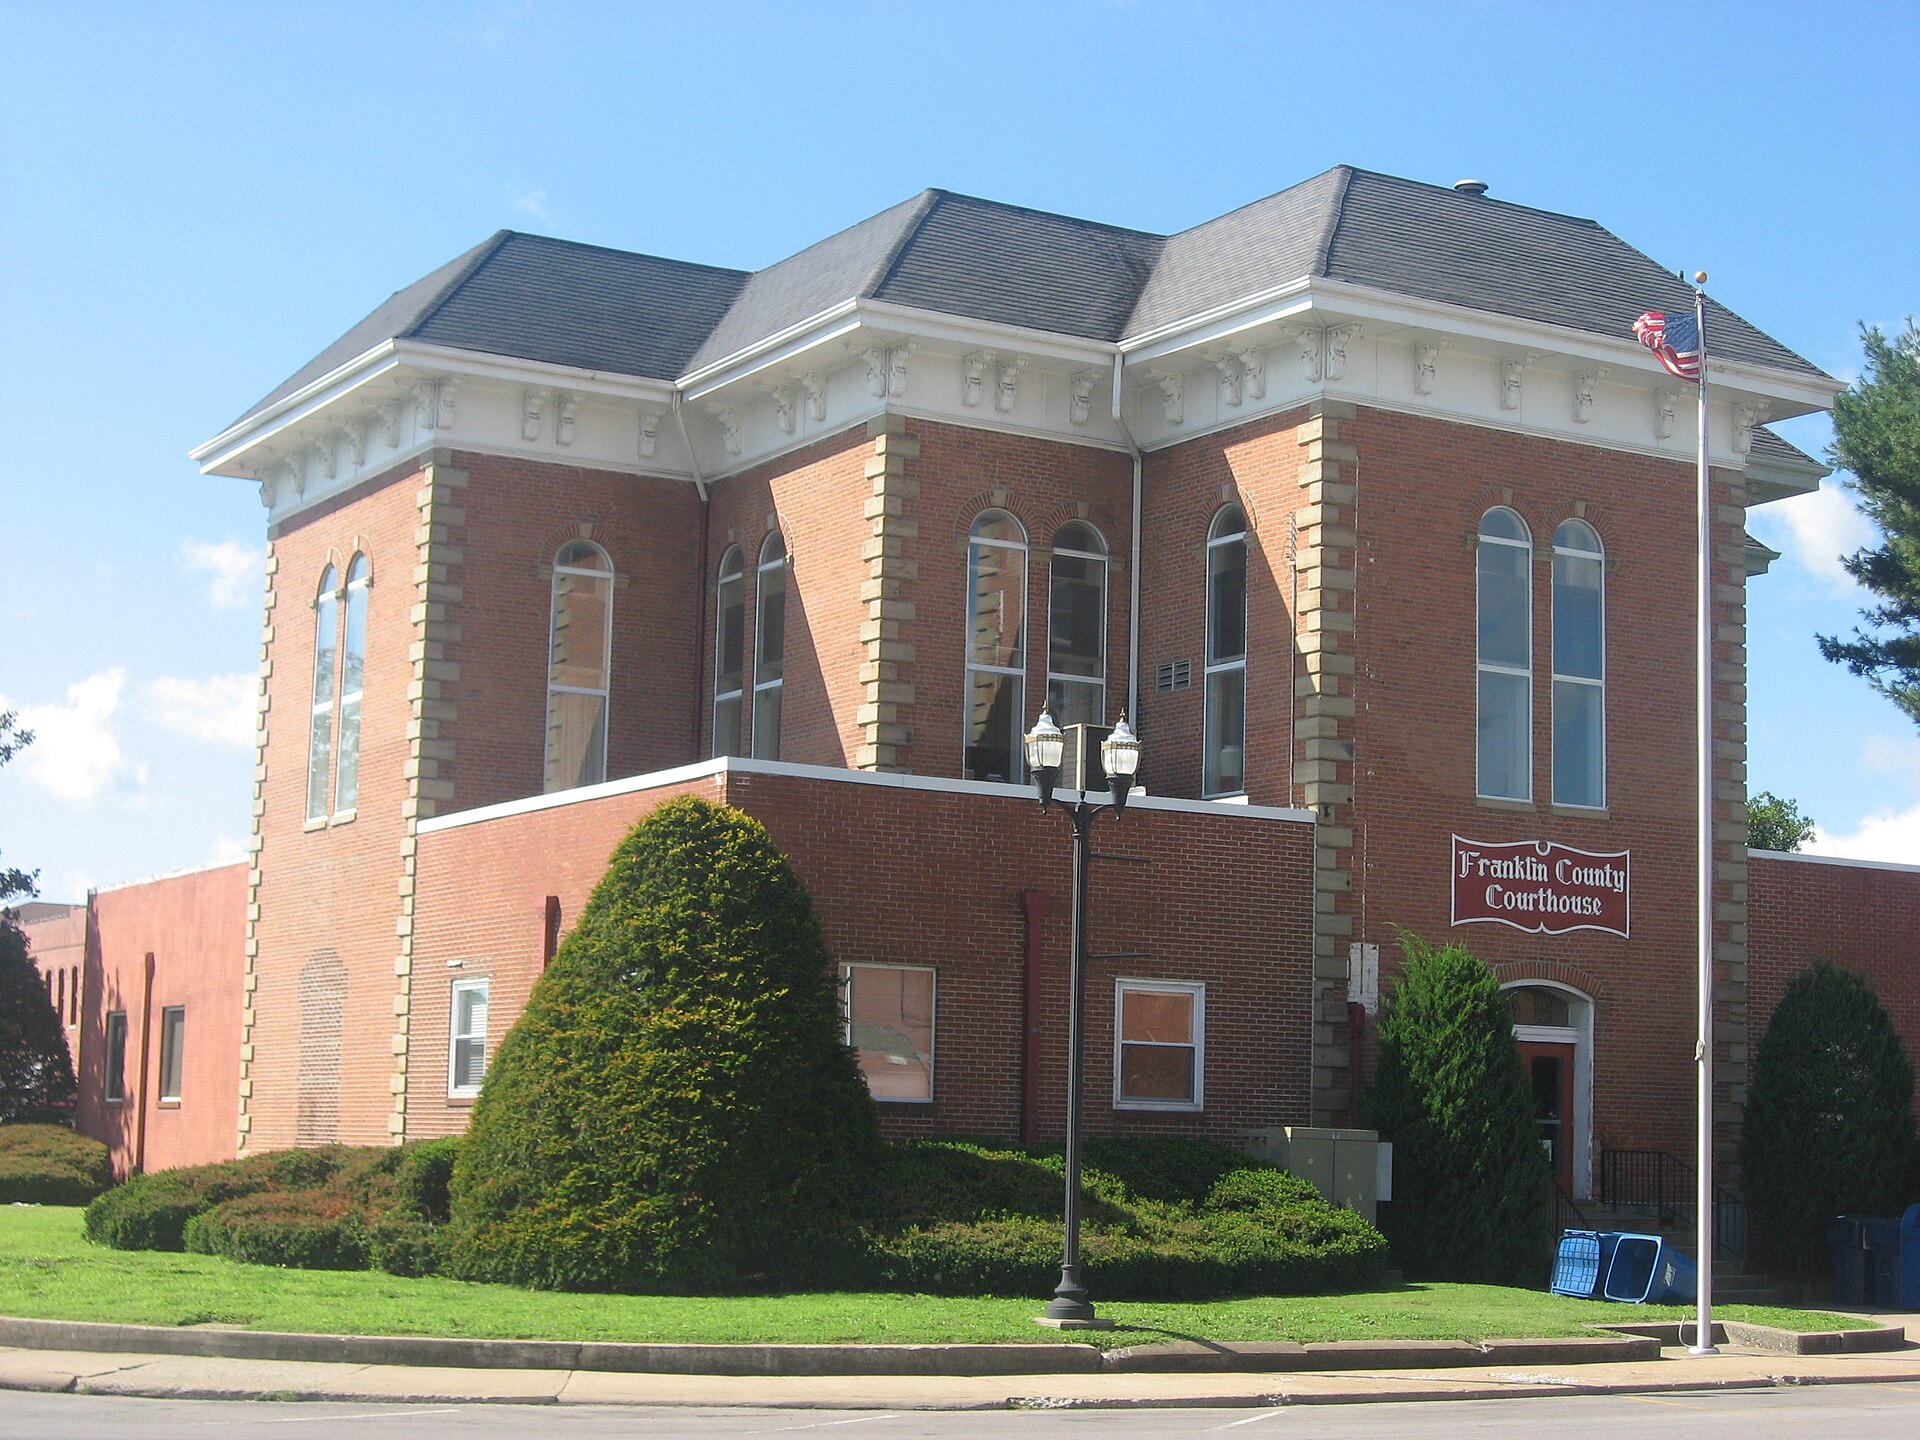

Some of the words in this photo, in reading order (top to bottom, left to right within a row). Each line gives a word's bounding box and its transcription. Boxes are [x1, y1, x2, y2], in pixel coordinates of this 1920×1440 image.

[1458, 850, 1549, 882] Franklin
[1555, 858, 1626, 893] County
[1485, 884, 1602, 915] Courthouse
